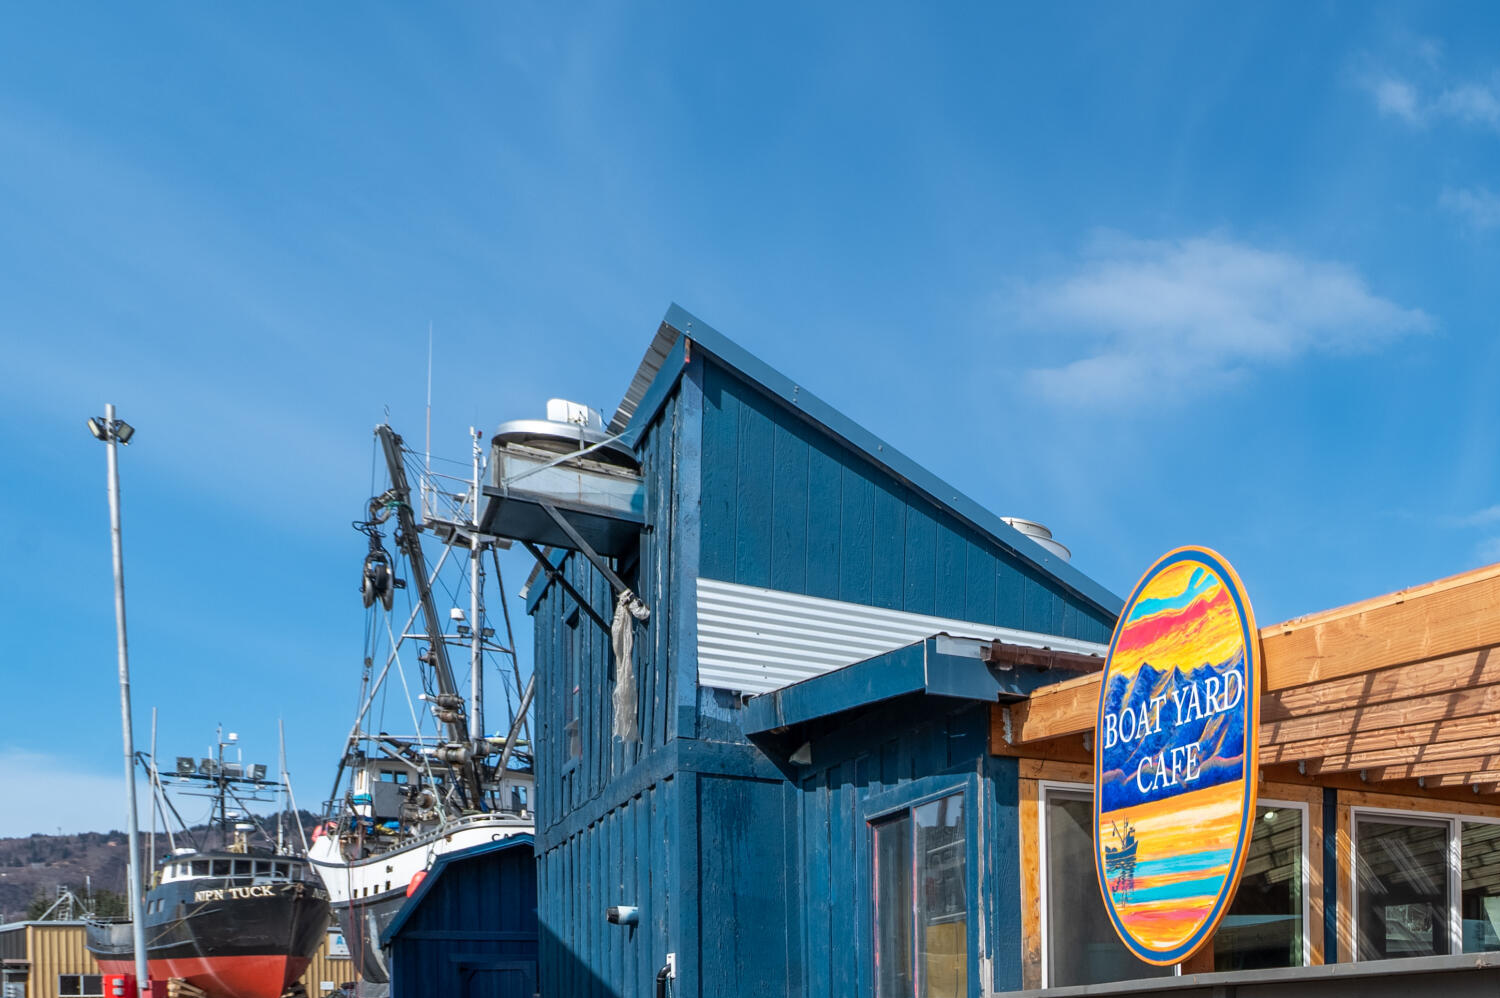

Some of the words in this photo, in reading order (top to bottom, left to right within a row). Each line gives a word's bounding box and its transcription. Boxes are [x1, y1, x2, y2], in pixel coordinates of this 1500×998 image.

[1104, 694, 1167, 749] BOAT
[1171, 669, 1243, 727] YARD
[1136, 741, 1201, 793] CAFE
[228, 885, 276, 899] TUCK
